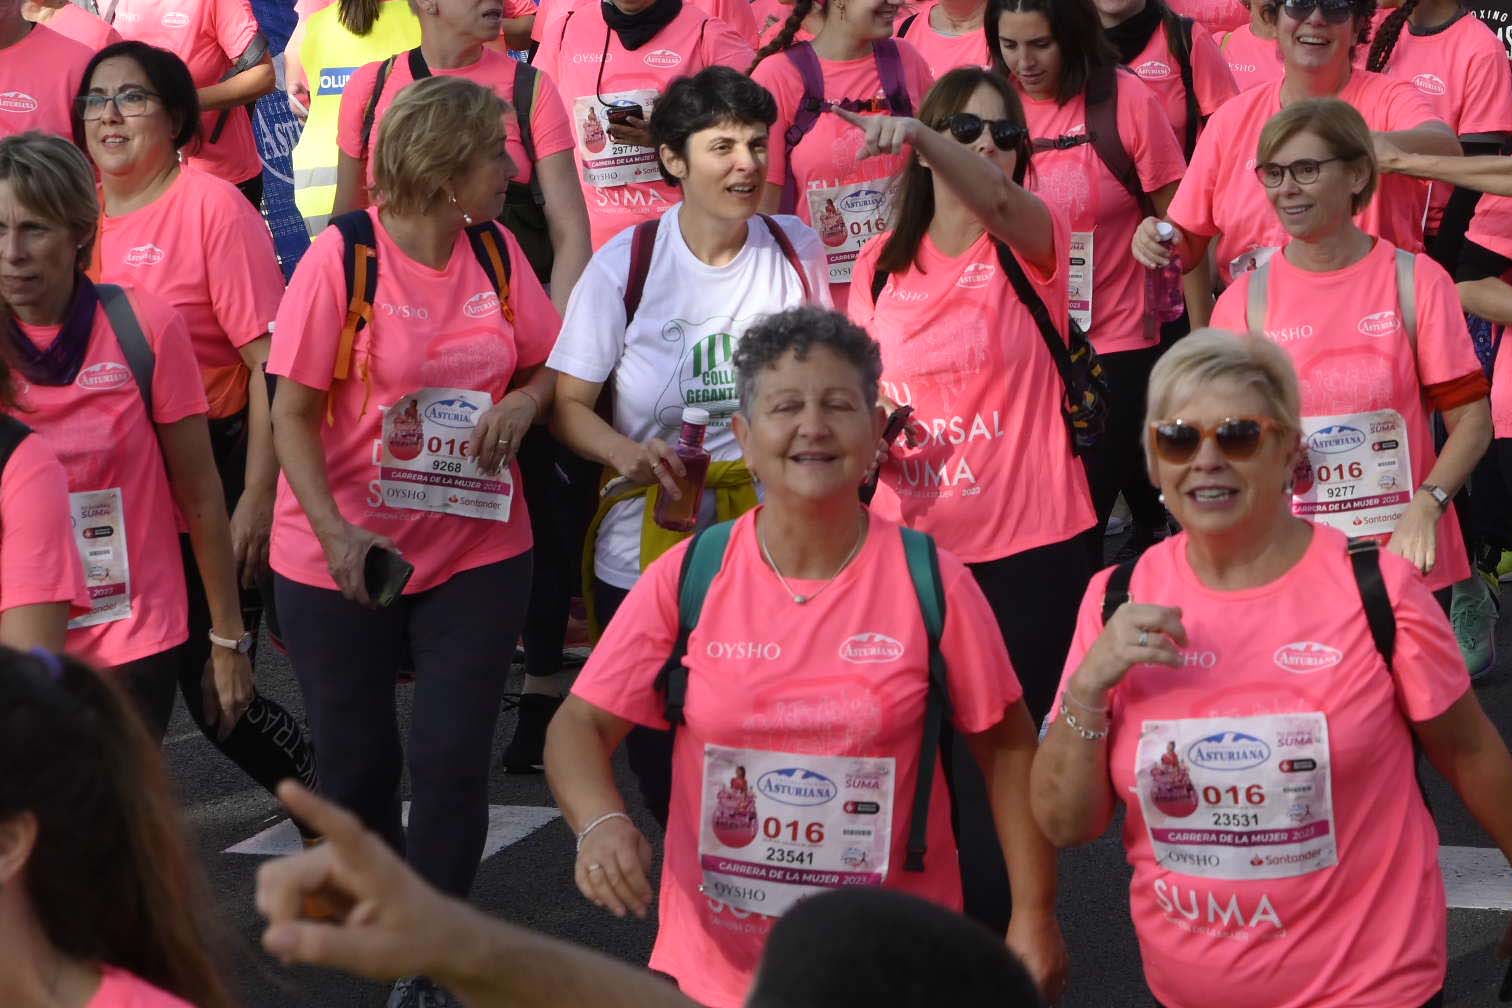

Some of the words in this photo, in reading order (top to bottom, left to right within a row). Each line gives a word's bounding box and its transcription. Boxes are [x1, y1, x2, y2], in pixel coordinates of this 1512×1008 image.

[850, 218, 888, 235] 016
[432, 460, 462, 473] 9268
[1317, 461, 1363, 482] 016
[391, 471, 429, 482] CARRERA
[454, 479, 481, 488] MUJER
[387, 487, 426, 501] OYSHO
[459, 496, 502, 510] Santander
[1327, 485, 1355, 498] 9277
[1329, 502, 1339, 511] DE
[1341, 501, 1352, 509] LA
[1353, 498, 1380, 508] MUJER
[707, 641, 781, 660] OYSHO
[1275, 651, 1339, 667] ASTURIANA
[1277, 737, 1314, 748] SUMA
[1196, 748, 1264, 762] ASTURIANA
[763, 779, 831, 799] ASTURIANA
[845, 778, 880, 790] SUMA
[1202, 784, 1265, 805] 016
[1212, 813, 1259, 827] 23531
[763, 817, 825, 844] 016
[1168, 832, 1217, 842] CARRERA
[1219, 833, 1234, 843] DE
[1235, 834, 1249, 843] LA
[1250, 831, 1288, 842] MUJER
[766, 847, 814, 865] 23541
[1168, 850, 1220, 867] OYSHO
[1265, 847, 1322, 866] Santander
[719, 862, 767, 877] CARRERA
[768, 869, 785, 879] DE
[786, 871, 800, 881] LA
[802, 873, 839, 884] MUJER
[714, 882, 766, 902] OYSHO
[1153, 879, 1283, 930] SUMA
